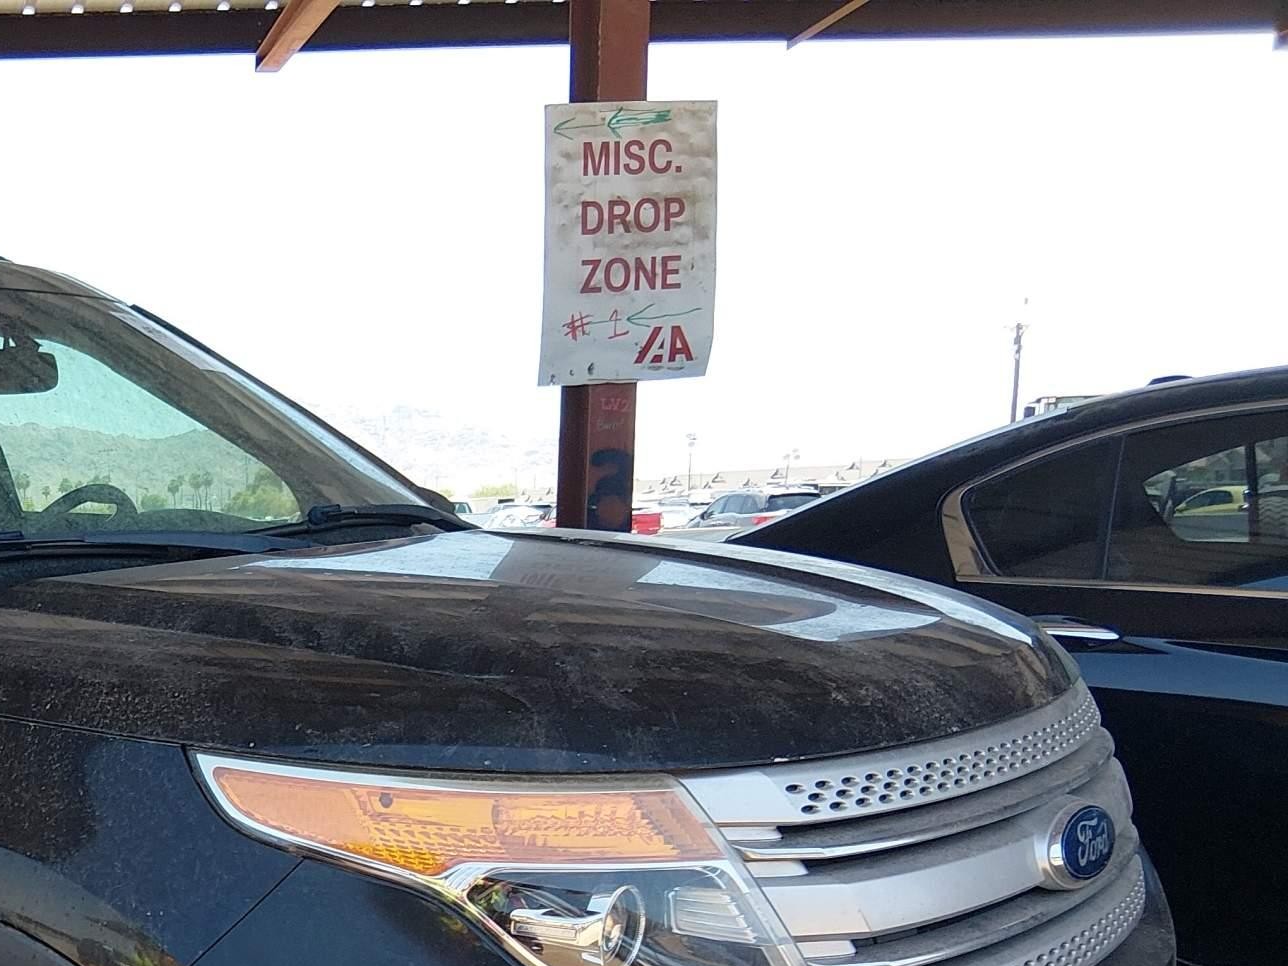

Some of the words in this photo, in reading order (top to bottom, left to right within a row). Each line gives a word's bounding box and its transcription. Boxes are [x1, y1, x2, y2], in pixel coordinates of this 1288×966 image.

[582, 139, 683, 177] MISC.
[580, 196, 686, 235] DROP
[580, 255, 682, 294] ZONE
[1076, 816, 1109, 867] Ford
